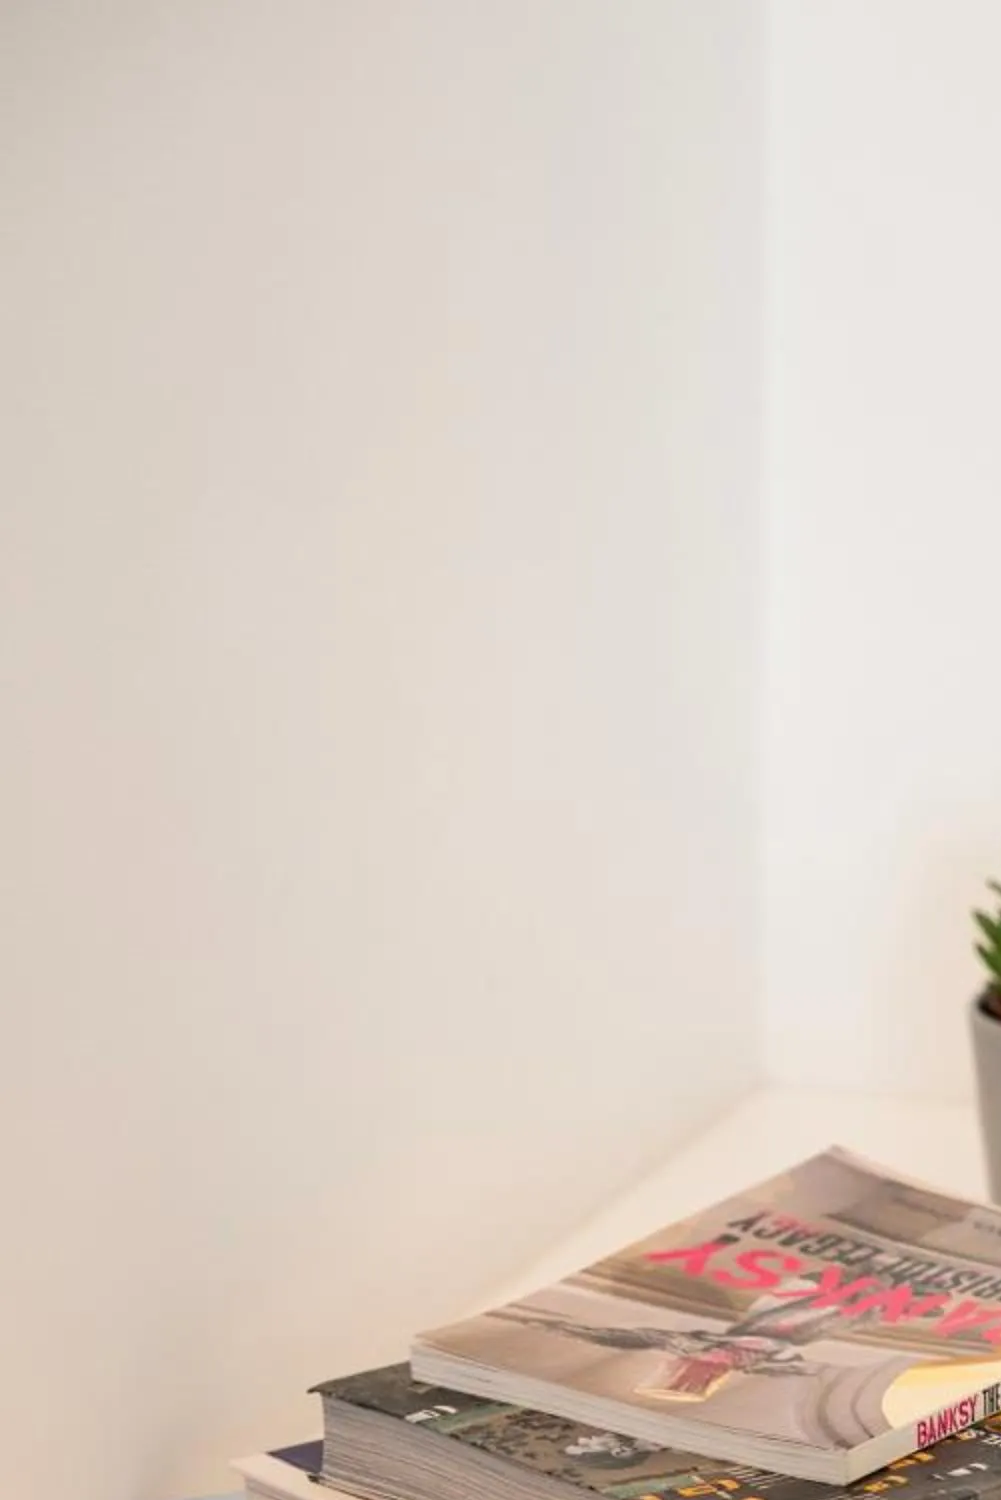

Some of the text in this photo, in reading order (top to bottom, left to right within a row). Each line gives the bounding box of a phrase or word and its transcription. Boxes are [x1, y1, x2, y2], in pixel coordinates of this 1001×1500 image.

[726, 1210, 883, 1268] LEGACY
[917, 1393, 979, 1450] BANKSY
[982, 1382, 1001, 1417] THE
